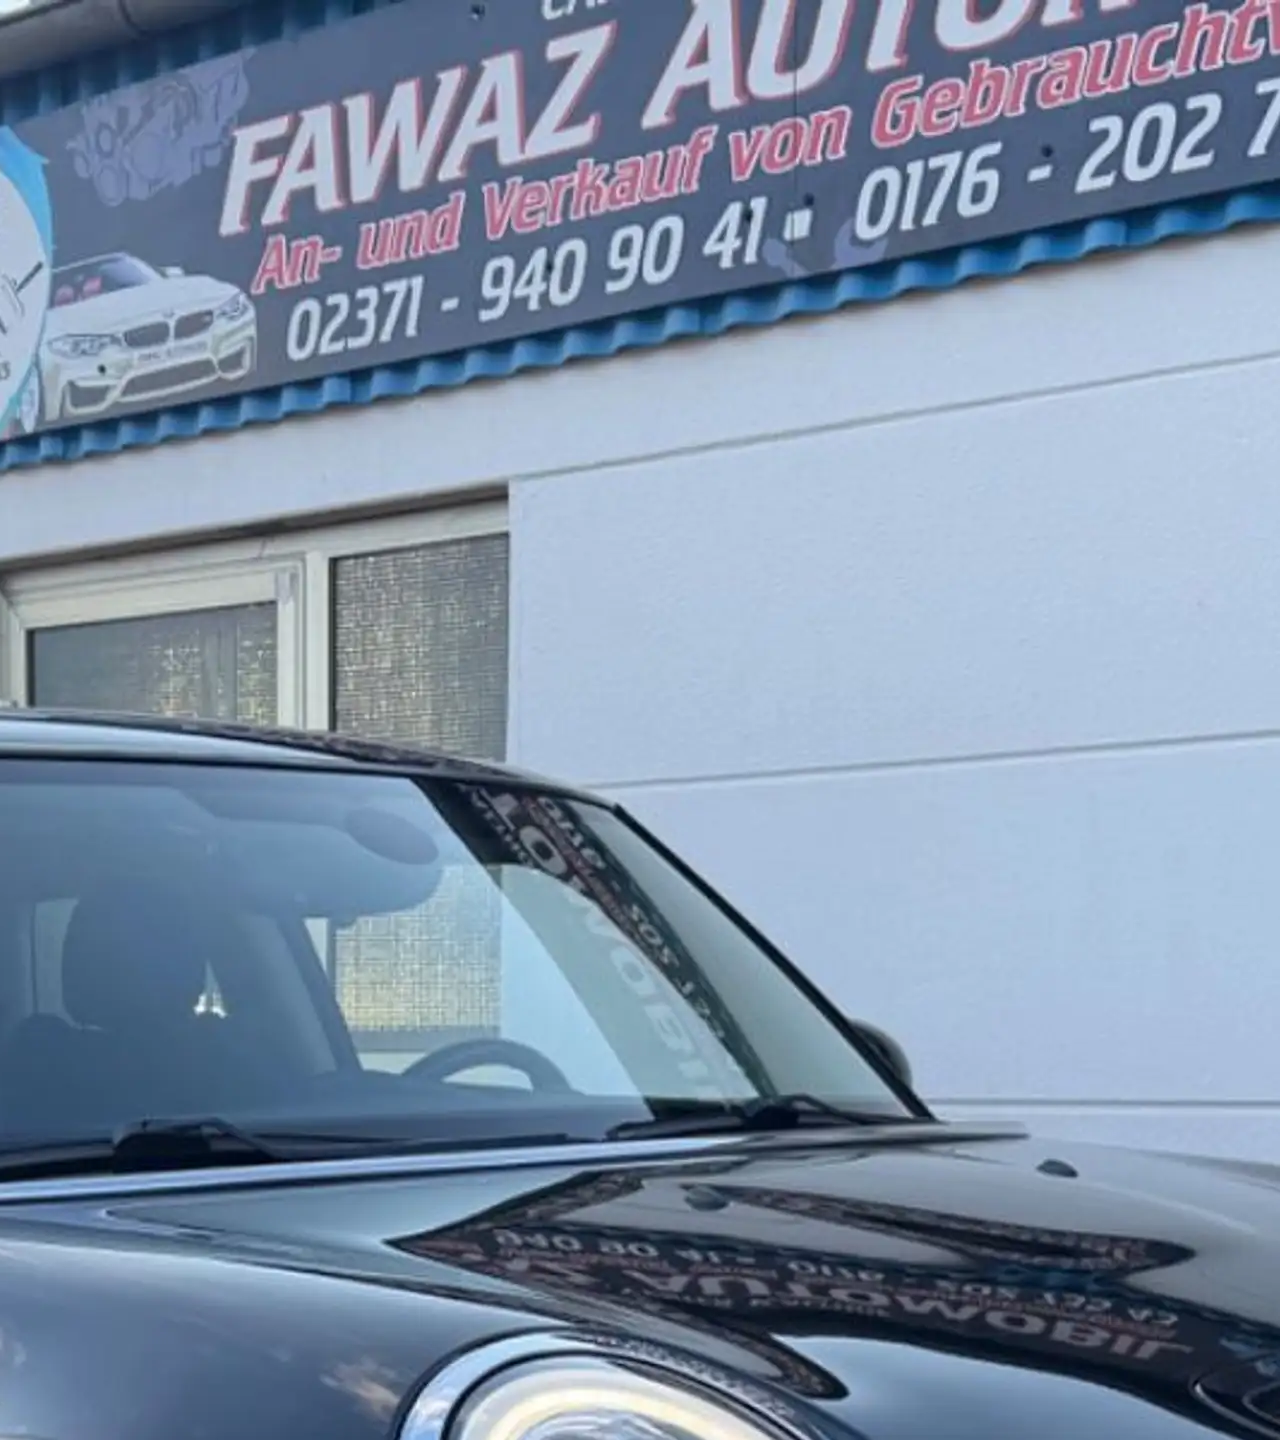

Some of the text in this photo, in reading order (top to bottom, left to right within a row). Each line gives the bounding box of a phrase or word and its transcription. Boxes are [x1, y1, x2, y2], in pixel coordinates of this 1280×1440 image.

[220, 20, 617, 237] FAWAZ
[251, 233, 342, 294] An-
[356, 194, 462, 269] und
[482, 123, 718, 240] Verkauf
[728, 105, 852, 182] von
[286, 275, 424, 361] 02371
[479, 238, 587, 322] 940
[605, 215, 685, 293] 90
[703, 196, 768, 269] 41
[855, 141, 1002, 241] 0176
[1075, 93, 1222, 194] 202
